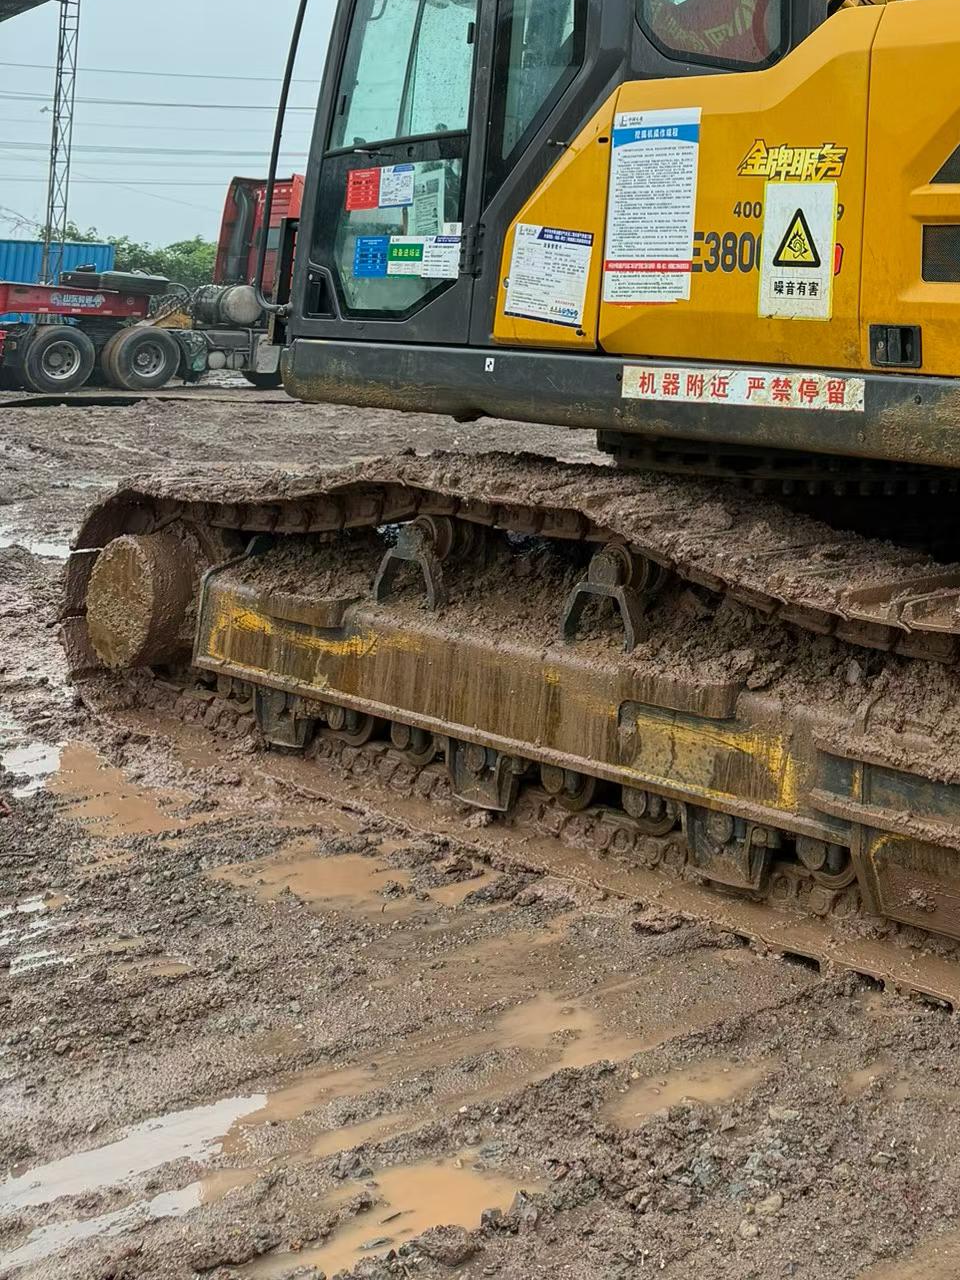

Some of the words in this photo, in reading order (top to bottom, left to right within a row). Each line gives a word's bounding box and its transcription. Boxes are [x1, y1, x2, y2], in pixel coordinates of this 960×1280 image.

[737, 138, 848, 182] 金牌服务
[773, 280, 819, 297] 噪音有害
[638, 371, 729, 399] 机器附近
[745, 375, 846, 405] 严禁停留
